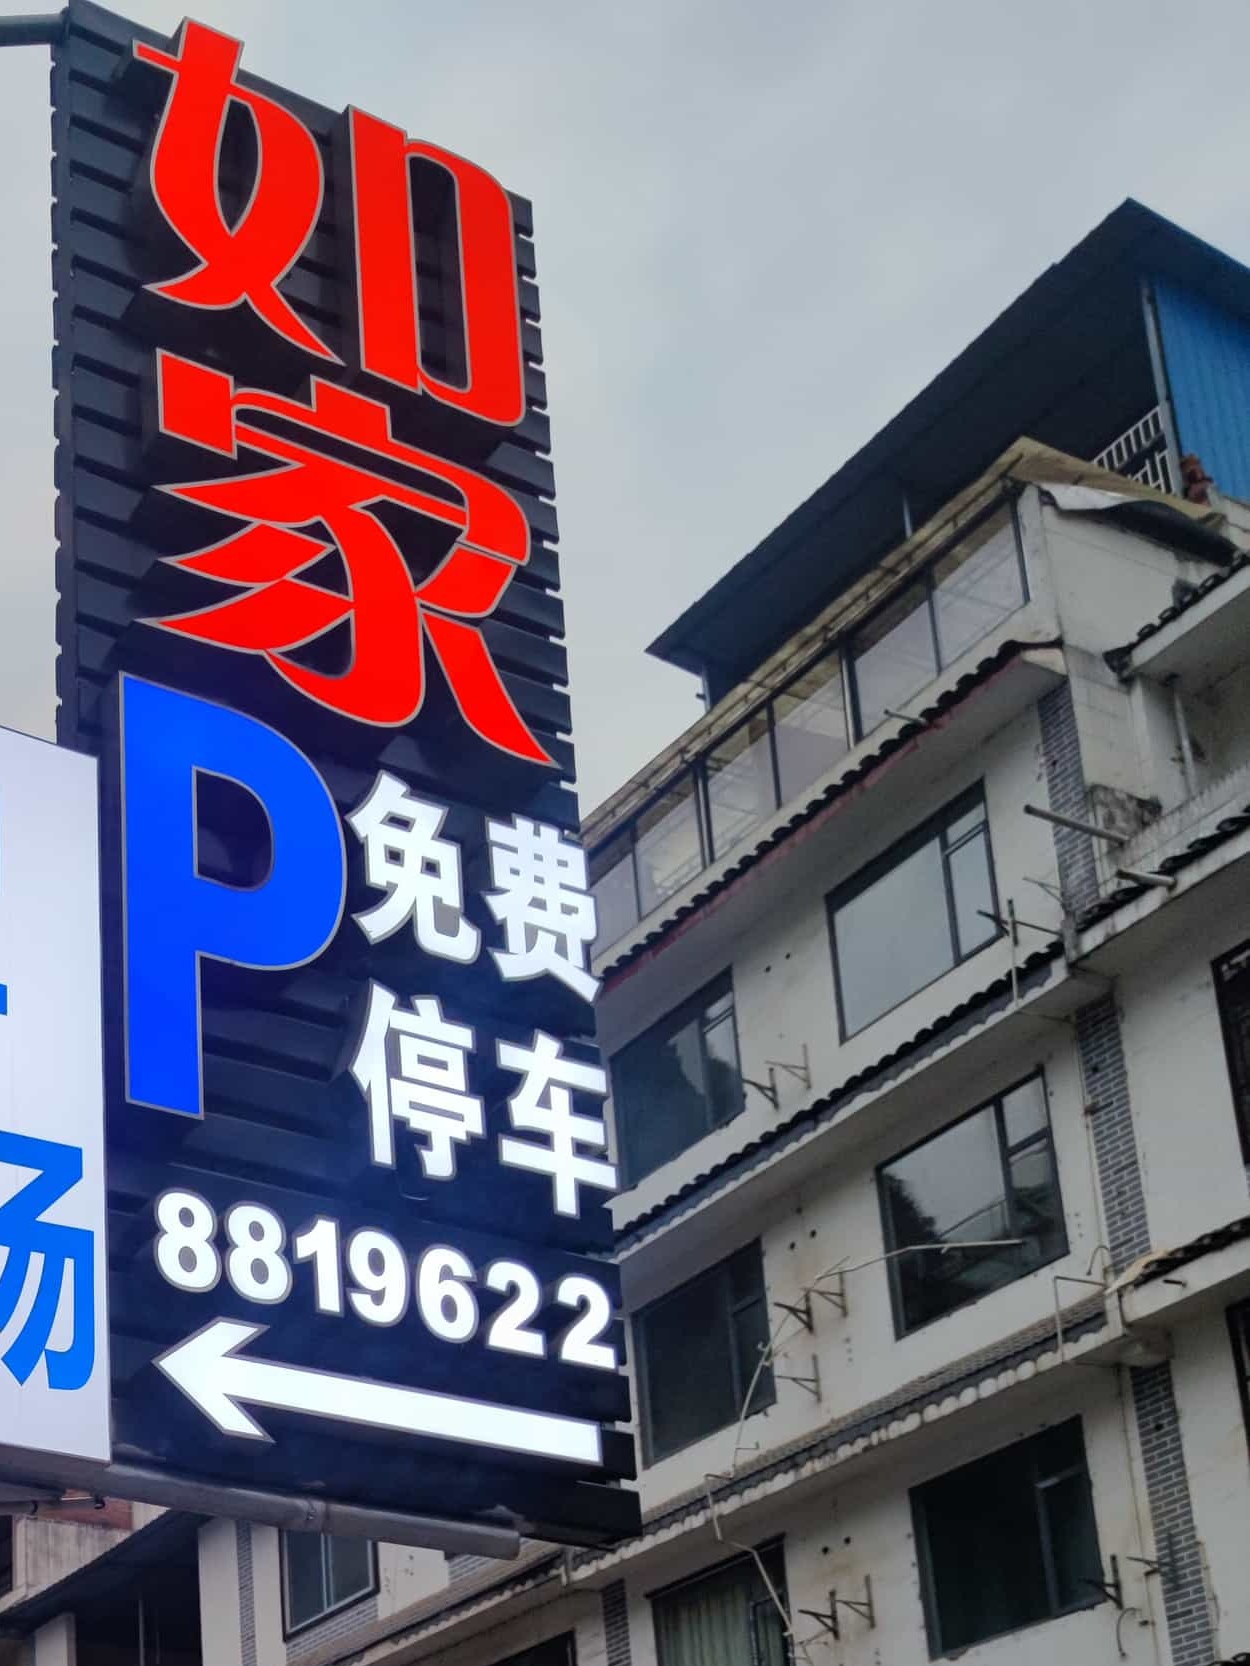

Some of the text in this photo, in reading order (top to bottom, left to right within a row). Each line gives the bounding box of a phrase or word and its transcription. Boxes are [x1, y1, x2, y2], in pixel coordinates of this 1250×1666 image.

[132, 16, 563, 768] 如家
[118, 670, 349, 1120] P
[344, 769, 603, 1004] 免费
[349, 978, 618, 1219] 停车
[153, 1188, 618, 1371] 8819622
